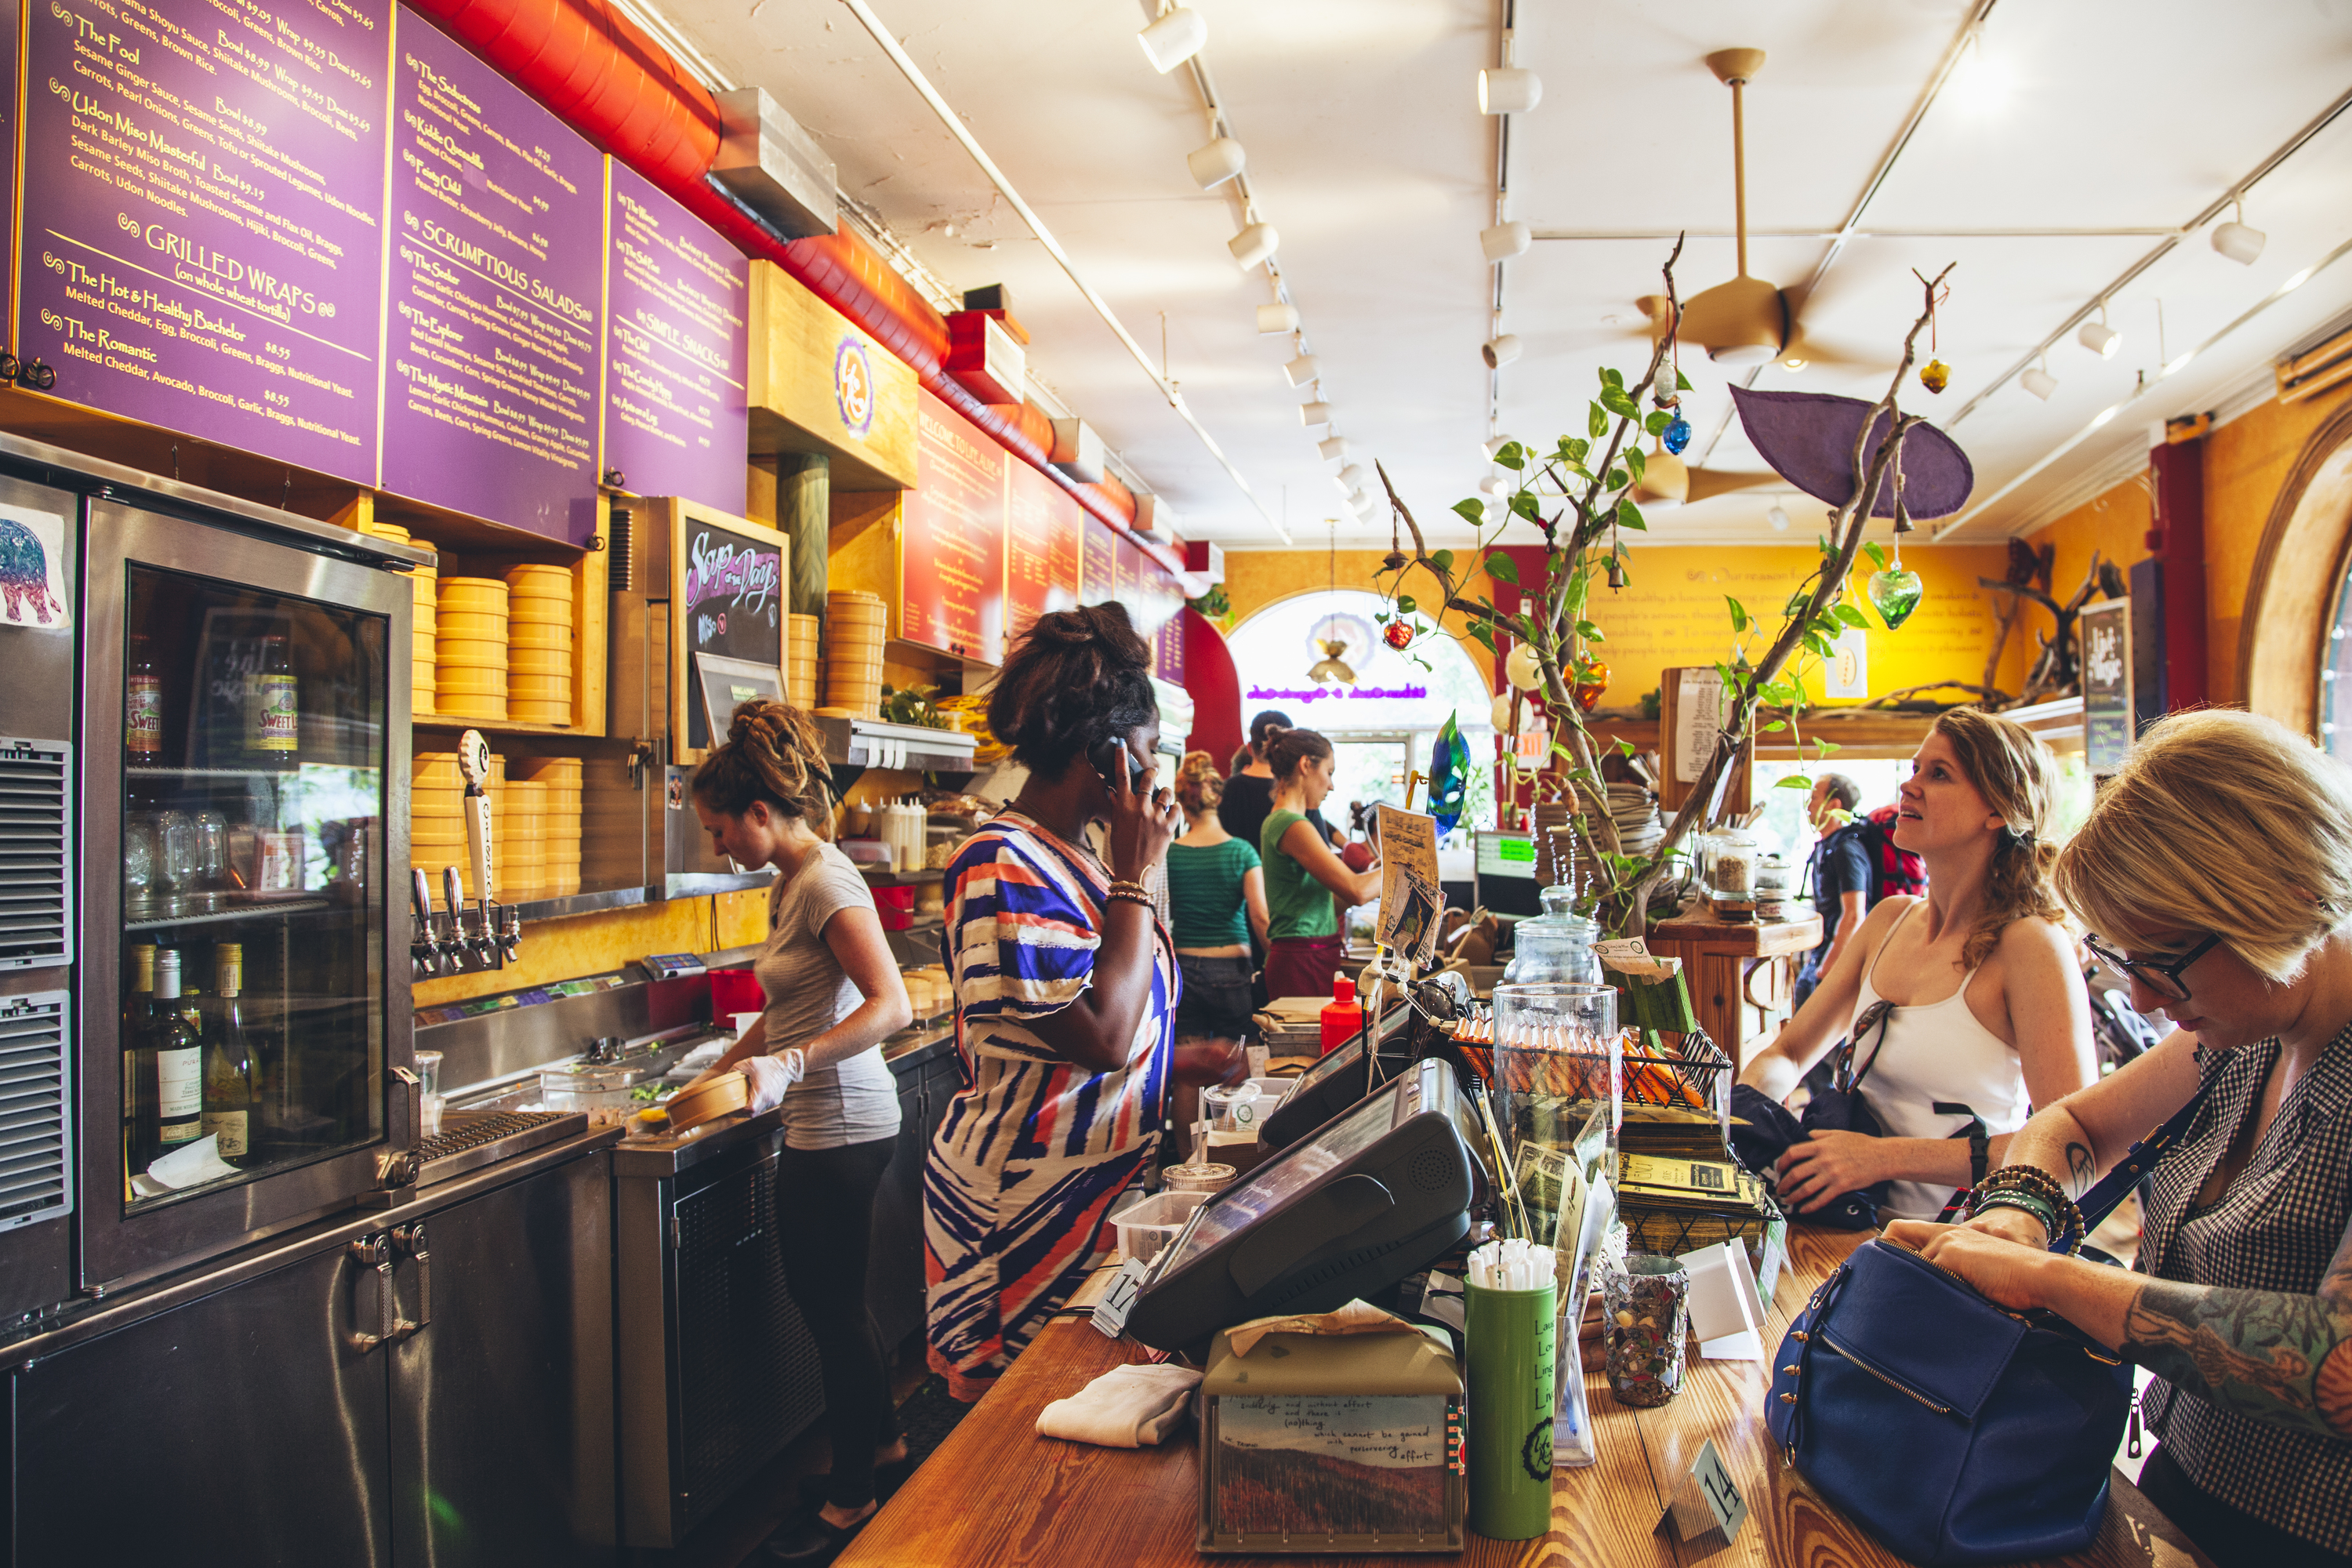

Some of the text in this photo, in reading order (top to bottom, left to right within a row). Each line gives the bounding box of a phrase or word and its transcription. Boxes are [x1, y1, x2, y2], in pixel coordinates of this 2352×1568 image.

[74, 14, 267, 136] The Fool Bowl $8.99
[217, 29, 370, 132] Bowl $8.99 Wrap $9.45 Demi $5.65
[419, 60, 437, 84] The
[437, 75, 481, 114] Seductress
[72, 91, 264, 201] Udon Miso Masterful Bowl $9.15
[74, 39, 326, 186] Sesame Ginger Sauce, Sesame Seeds, Shiitake Mushrooms,
[74, 60, 376, 227] Carrots, Pearl Onions, Greens, Tofu or Sprouted Legumes, Udon Noodles.
[416, 116, 484, 169] Kiddie Quesadilla
[71, 154, 188, 217] Carrots, Udon Noodles.
[71, 134, 336, 270] Sesame Seeds, Shiitake Mushrooms, Hijiki, Broccoli, Greens,
[72, 114, 343, 256] Dark Barley Miso Broth, Toasted Sesame and Flax Oil, Braggs,
[415, 158, 461, 196] Feisty Child
[145, 224, 315, 314] GRILLED WRAPS
[175, 262, 290, 323] (on whole wheat tortilla)
[412, 251, 459, 285] The Seeker
[422, 220, 582, 320] SCRUMPTIOUS SALADS
[66, 260, 290, 360] The Hot & Healthy Bachelor $8.55
[66, 285, 354, 398] Melted Cheddar, Egg, Broccoli, Greens, Braggs, Nutritional Yeast.
[410, 307, 463, 342] The Explorer
[645, 313, 720, 368] SIMPLE SNACKS
[64, 316, 289, 407] The Romantic $8.55
[64, 342, 361, 445] Melted Cheddar, Avocado, Broccoli, Garlic, Braggs, Nutritional Yeast.
[408, 365, 488, 407] The Mystic Mountain
[731, 548, 777, 615] Day
[258, 709, 290, 728] SWEET
[1538, 1341, 1555, 1357] Lov
[1534, 1387, 1555, 1410] Liv
[1704, 1455, 1740, 1526] 14
